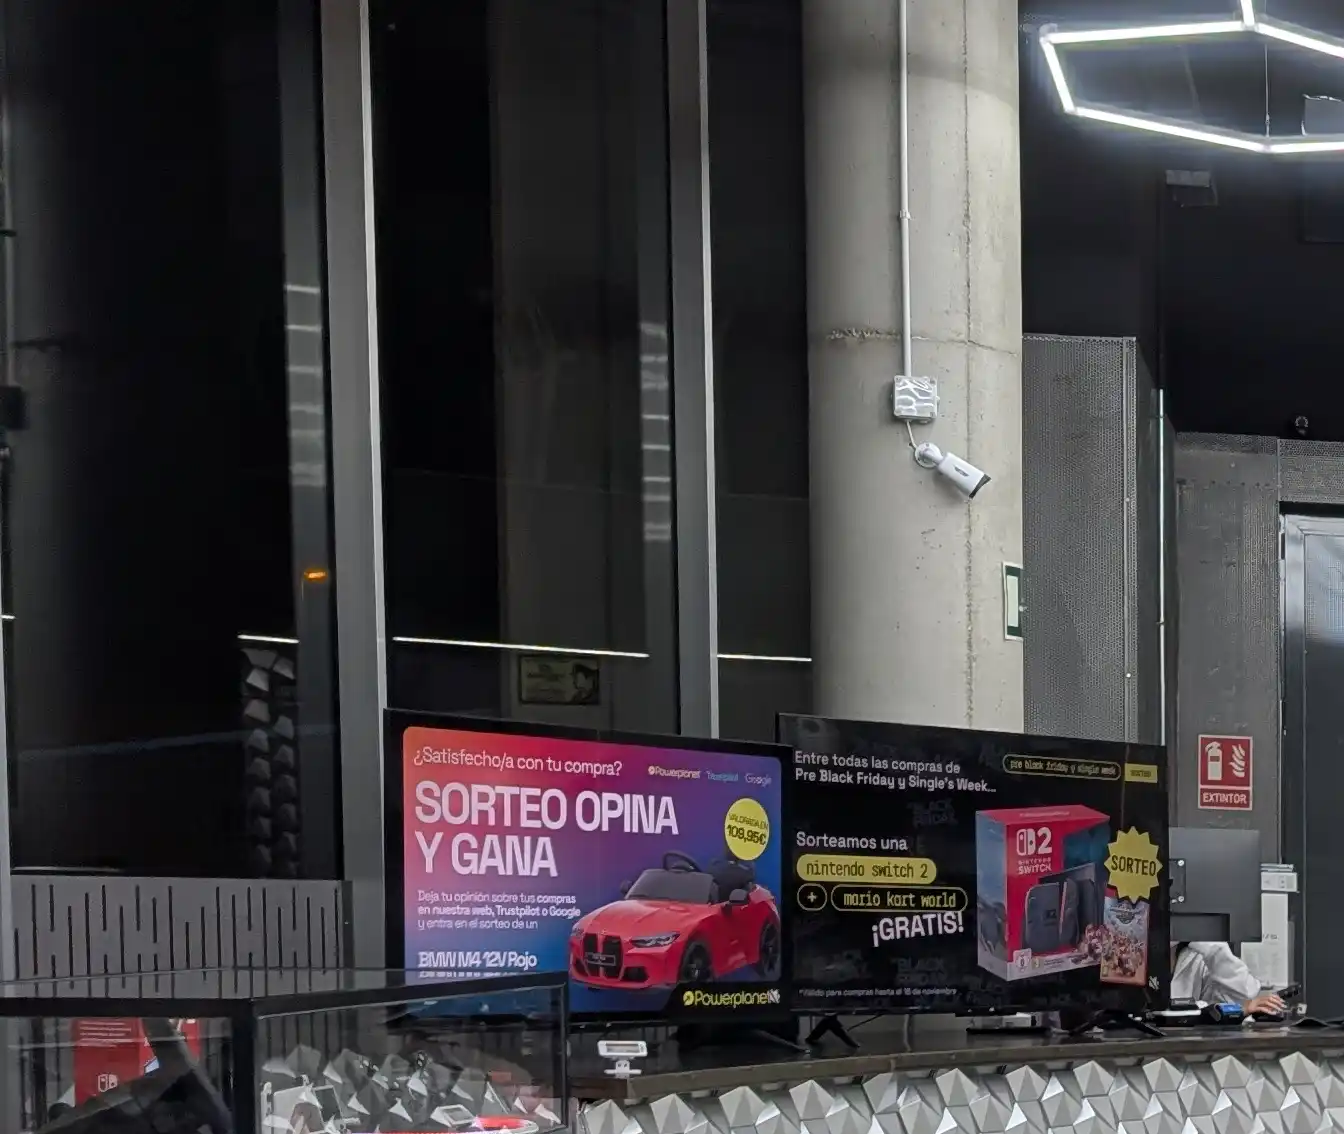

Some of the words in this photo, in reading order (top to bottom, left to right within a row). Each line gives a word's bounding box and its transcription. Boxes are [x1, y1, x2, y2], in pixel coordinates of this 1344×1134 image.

[413, 746, 514, 772] ¿Satisfecho/a
[517, 757, 544, 770] con
[546, 757, 562, 772] tu
[564, 761, 623, 778] compra?
[795, 750, 829, 766] Entre
[832, 753, 869, 768] todas
[871, 755, 889, 770] las
[891, 759, 943, 774] compras
[945, 761, 961, 774] de
[795, 767, 816, 781] Pre
[819, 769, 854, 785] Black
[856, 771, 895, 789] Friday
[897, 778, 906, 790] y
[415, 780, 568, 830] SORTEO
[575, 790, 679, 835] OPINA
[1202, 792, 1247, 804] EXTINTOR
[796, 830, 877, 850] Sorteamos
[880, 837, 908, 851] una
[415, 830, 444, 873] Y
[451, 832, 558, 877] GANA
[806, 860, 865, 877] nintendo
[872, 862, 914, 878] switch
[920, 863, 928, 879] 2
[1018, 863, 1052, 875] SWITCH
[1111, 855, 1157, 877] SORTEO
[417, 890, 439, 904] Deja
[441, 891, 453, 902] tu
[492, 891, 518, 903] sobre
[519, 892, 535, 904] tus
[536, 894, 577, 905] compras
[843, 890, 881, 907] mario
[886, 890, 916, 907] kart
[920, 891, 957, 908] world
[417, 905, 431, 916] en
[432, 905, 470, 916] nuestra
[495, 904, 540, 917] Trustpilot
[541, 908, 548, 916] o
[549, 906, 581, 919] Google
[417, 919, 426, 931] y
[427, 918, 453, 929] entra
[454, 919, 467, 929] en
[469, 917, 479, 929] el
[479, 918, 511, 929] sorteo
[512, 918, 524, 929] de
[525, 920, 538, 930] un
[872, 911, 964, 948] ¡GRATIS!
[418, 951, 457, 968] BMW
[458, 951, 482, 968] M4
[482, 951, 507, 968] 12V
[507, 951, 538, 971] Rojo
[695, 990, 770, 1008] Powerplanet
